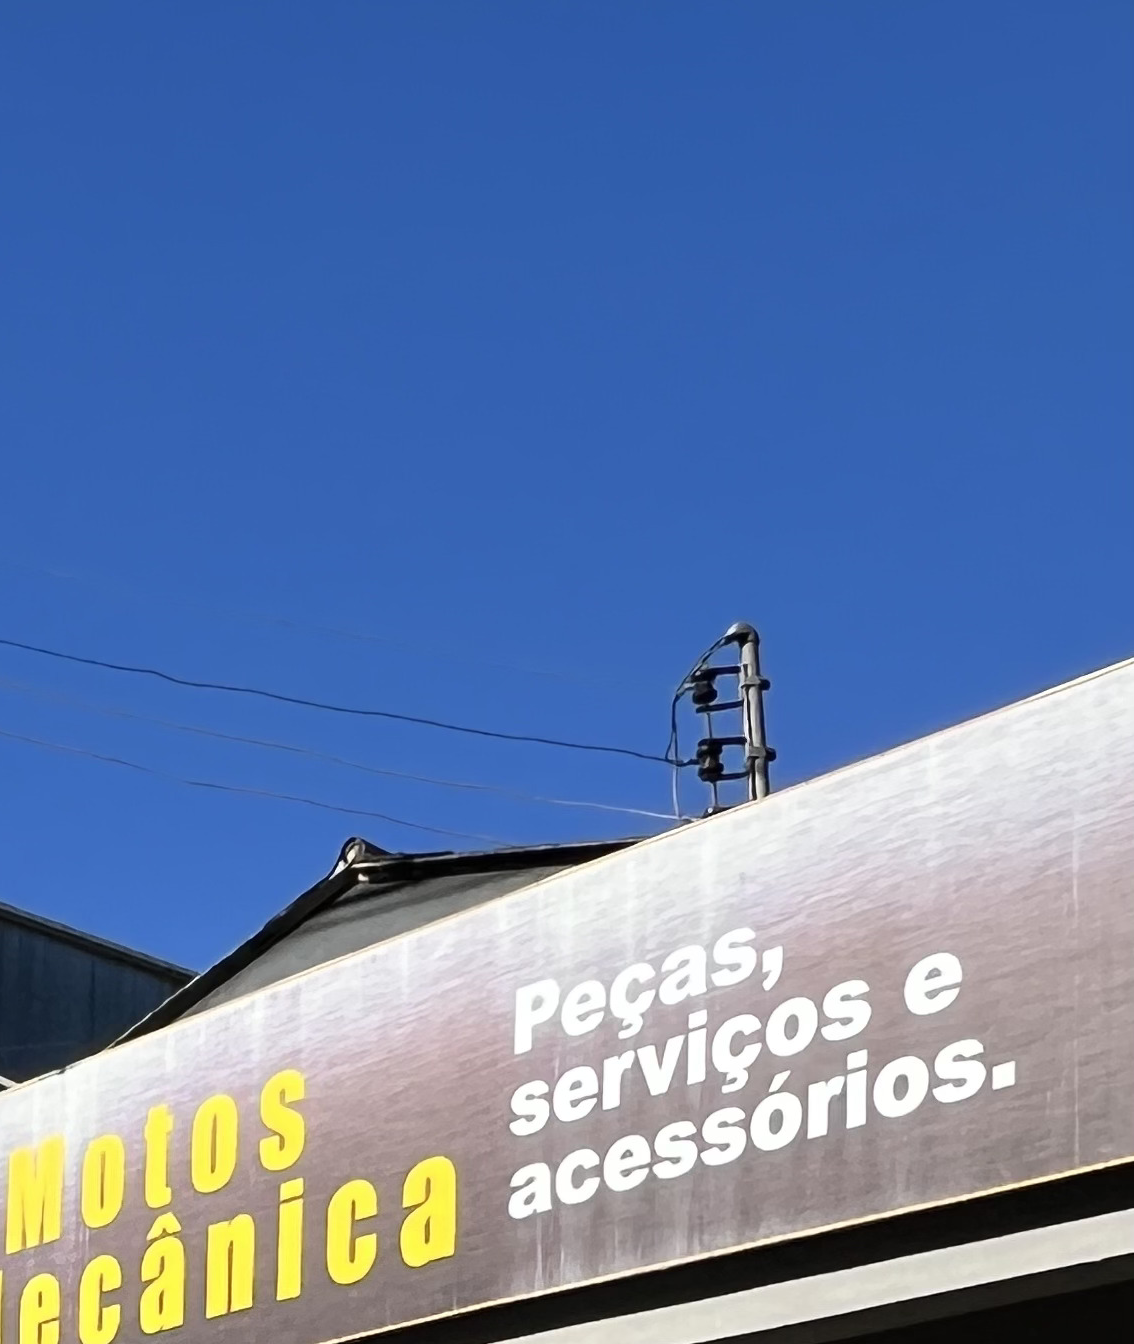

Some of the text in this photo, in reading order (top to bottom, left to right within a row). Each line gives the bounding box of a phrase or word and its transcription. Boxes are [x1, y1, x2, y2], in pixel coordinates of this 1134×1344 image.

[509, 951, 964, 1136] serviços e
[514, 927, 783, 1054] Peças,
[6, 1068, 307, 1255] Motos
[507, 1037, 1017, 1220] acessórios.
